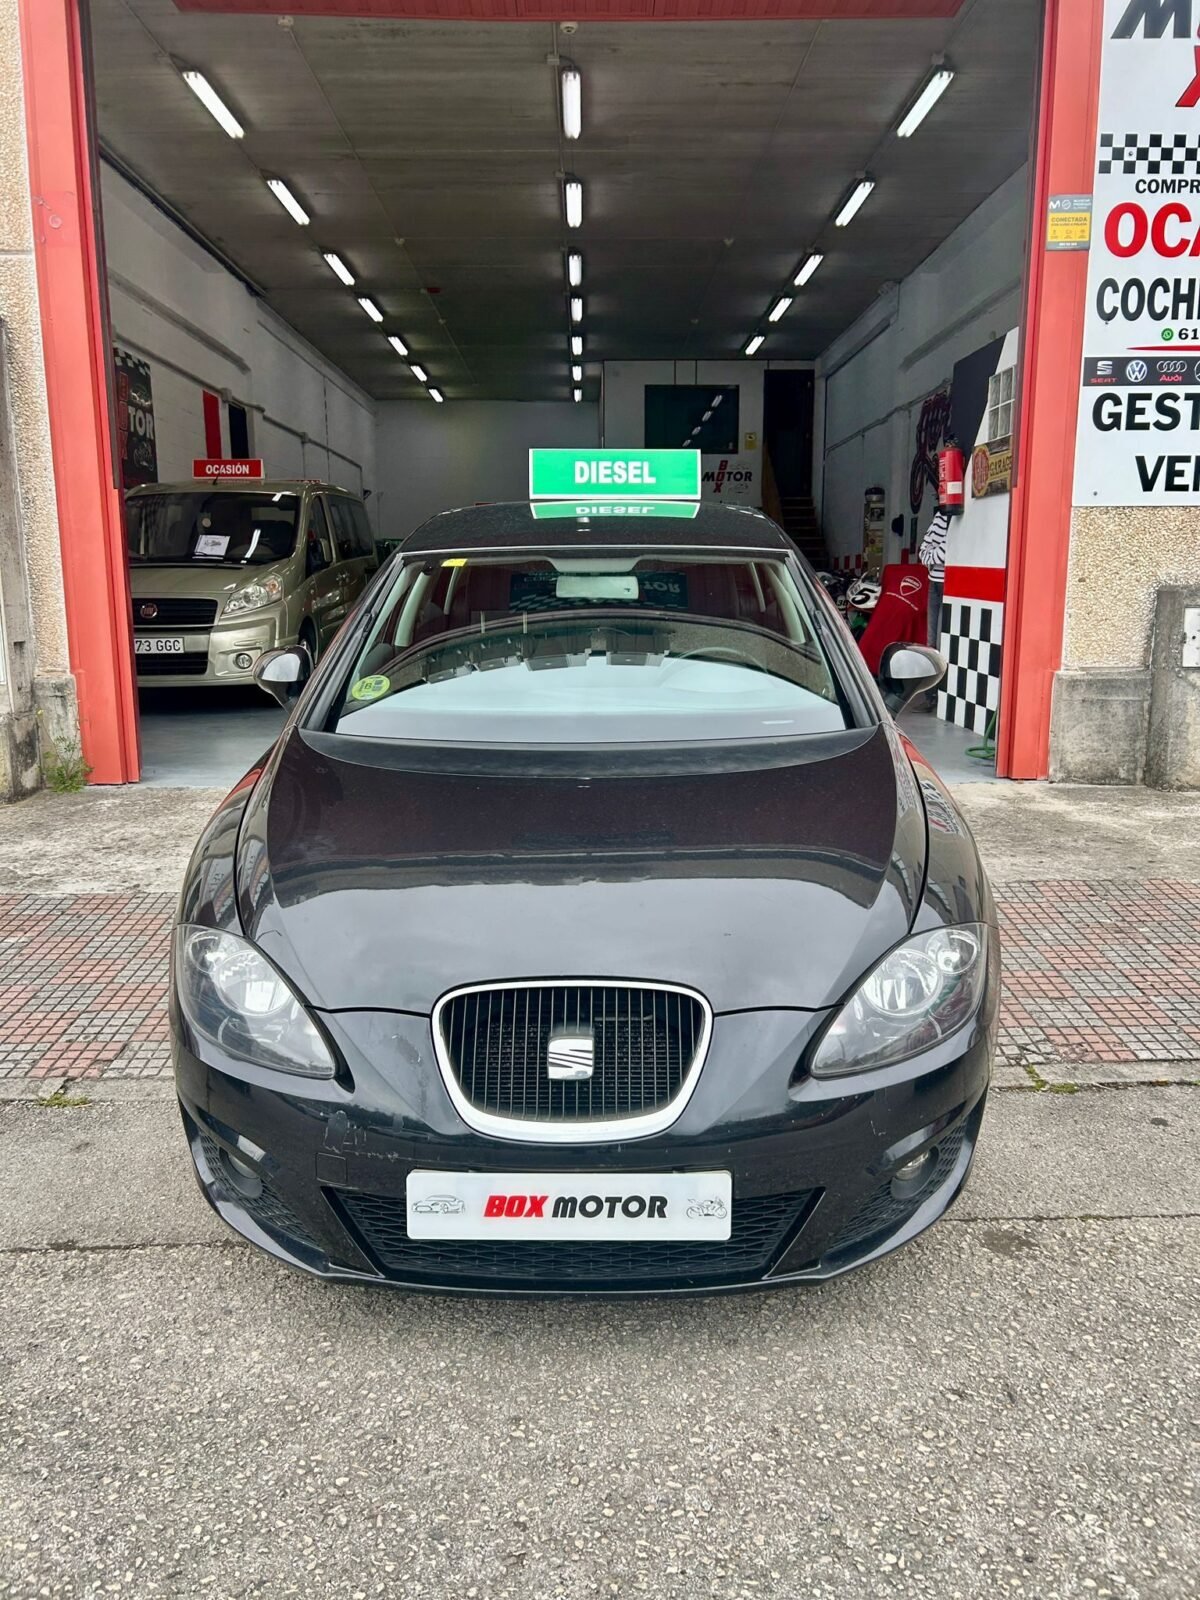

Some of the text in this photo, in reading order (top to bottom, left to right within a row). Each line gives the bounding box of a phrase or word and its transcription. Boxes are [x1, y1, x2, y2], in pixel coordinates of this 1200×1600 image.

[1110, 0, 1200, 39] M
[1105, 202, 1200, 258] OC
[1096, 278, 1200, 321] COCH
[1178, 328, 1200, 340] 61
[1160, 374, 1183, 382] Audi
[128, 405, 154, 440] TOR
[205, 462, 249, 474] OCASIÓN
[574, 461, 656, 484] DIESEL
[851, 587, 878, 605] 5
[136, 640, 181, 651] 73 GGC
[483, 1195, 668, 1218] BOX MOTOR
